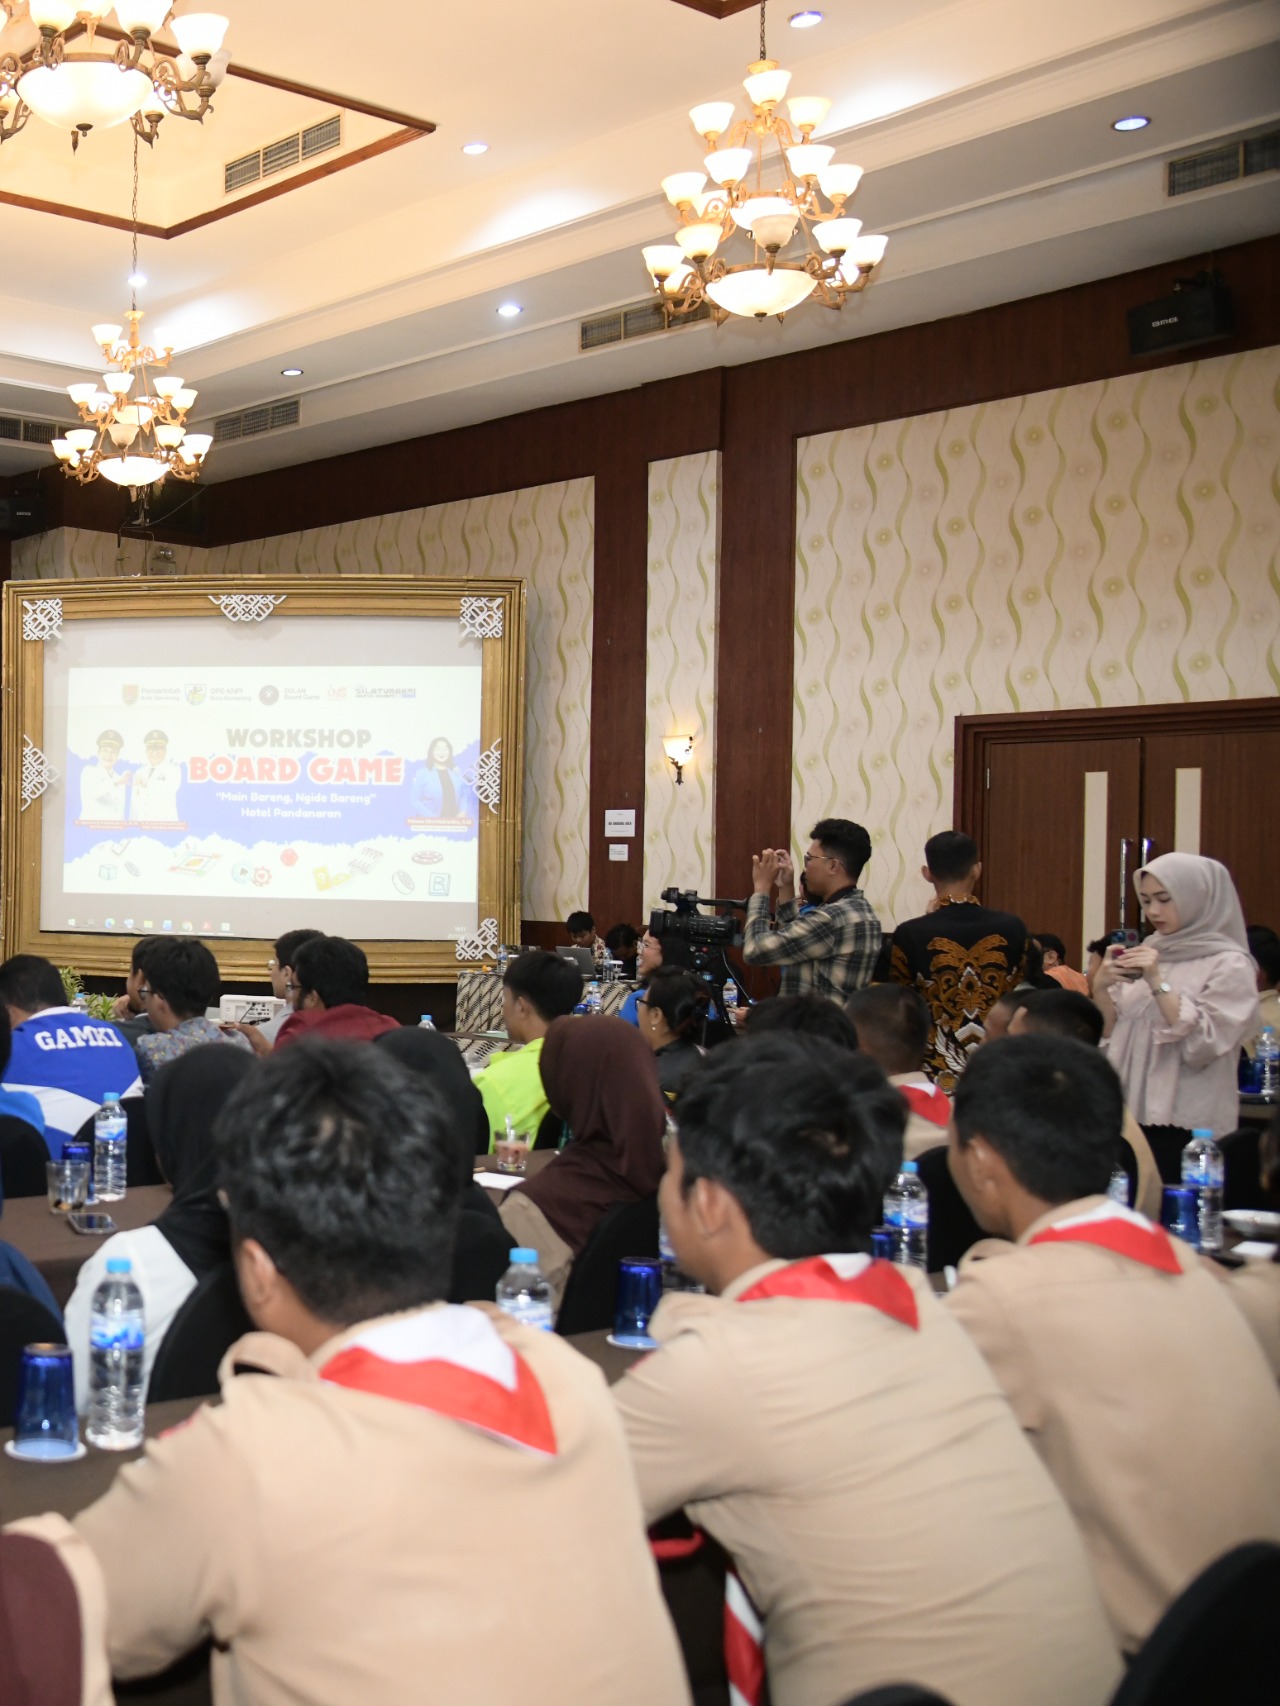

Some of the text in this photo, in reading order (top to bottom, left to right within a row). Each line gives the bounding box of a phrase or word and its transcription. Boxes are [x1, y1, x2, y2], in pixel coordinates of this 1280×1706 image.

[226, 728, 372, 748] WORKSHOP
[189, 756, 403, 783] BOARD GAME
[251, 792, 293, 804] Bareng,
[296, 793, 327, 804] Ngide
[241, 807, 341, 818] Hotel Pandanaran
[34, 1025, 122, 1051] GAMKI
